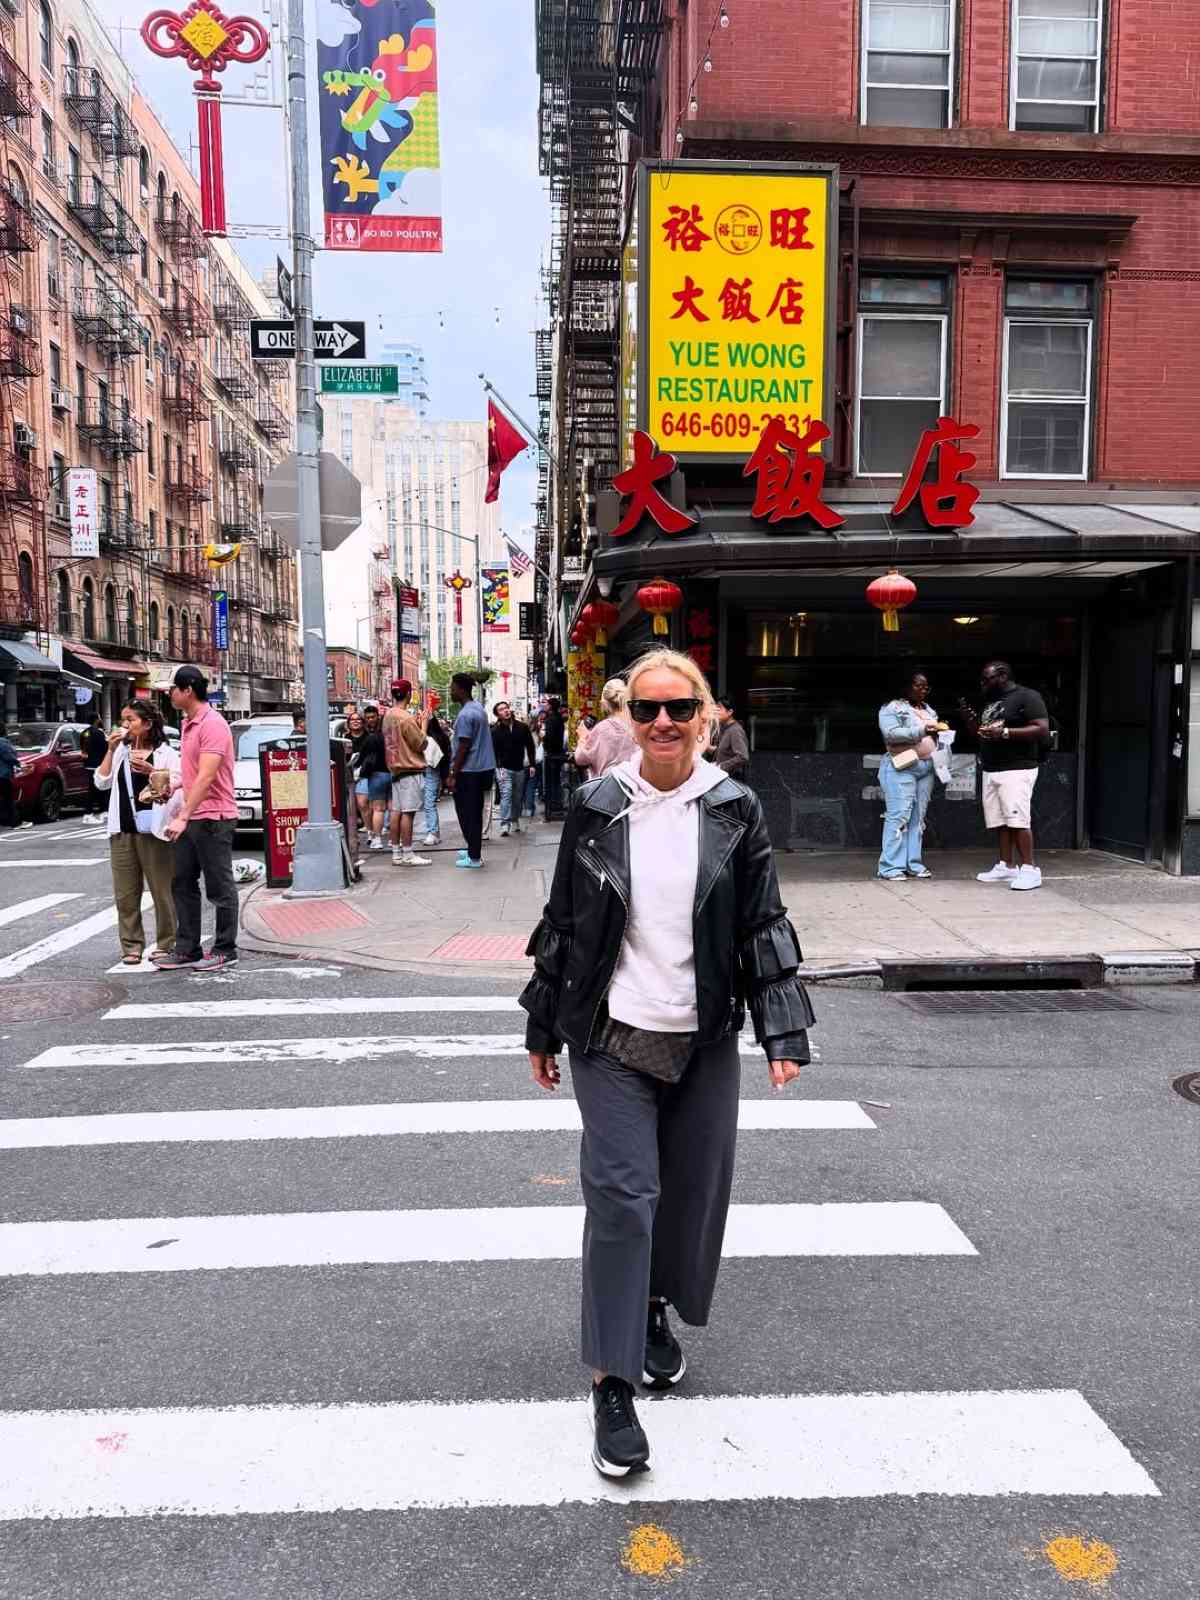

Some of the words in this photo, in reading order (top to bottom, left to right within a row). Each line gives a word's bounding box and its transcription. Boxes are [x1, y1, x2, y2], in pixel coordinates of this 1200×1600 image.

[396, 230, 438, 239] POULTRY
[669, 275, 804, 325] 大飯店
[315, 333, 348, 347] WAY
[669, 341, 720, 367] YUE
[728, 343, 806, 368] WONG
[323, 367, 383, 383] ELIZABETH
[657, 377, 814, 403] RESTAURANT
[661, 411, 811, 438] 646-609-231
[609, 416, 982, 536] 大飯店
[275, 816, 300, 826] SHOW
[276, 827, 295, 846] LO
